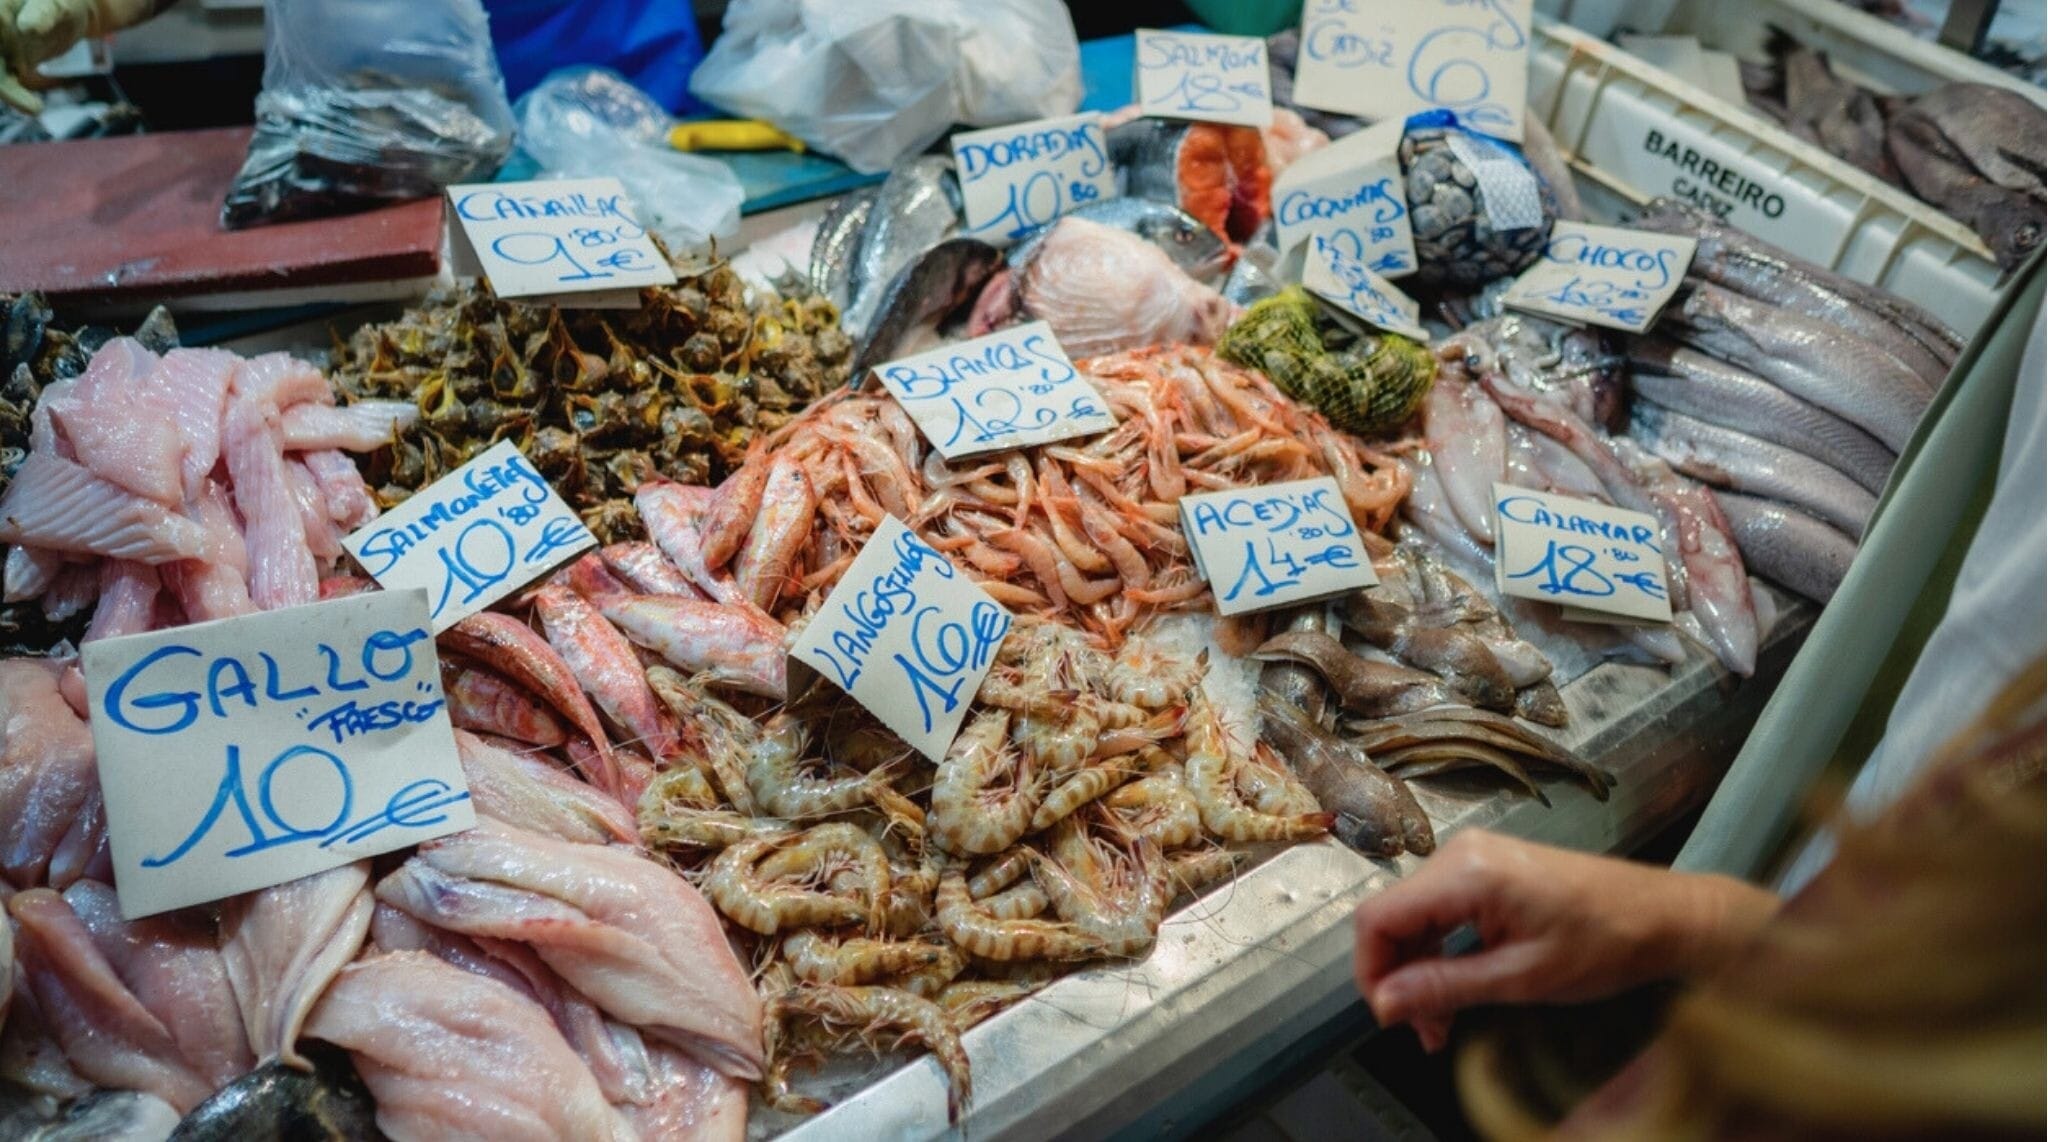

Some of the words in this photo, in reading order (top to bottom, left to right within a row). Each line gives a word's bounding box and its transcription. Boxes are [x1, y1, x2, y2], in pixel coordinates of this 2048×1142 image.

[1644, 130, 1786, 219] BARREIRO
[1544, 233, 1678, 290] CHOCOS
[1498, 496, 1662, 554] CALAMAR
[104, 628, 429, 734] GALLO
